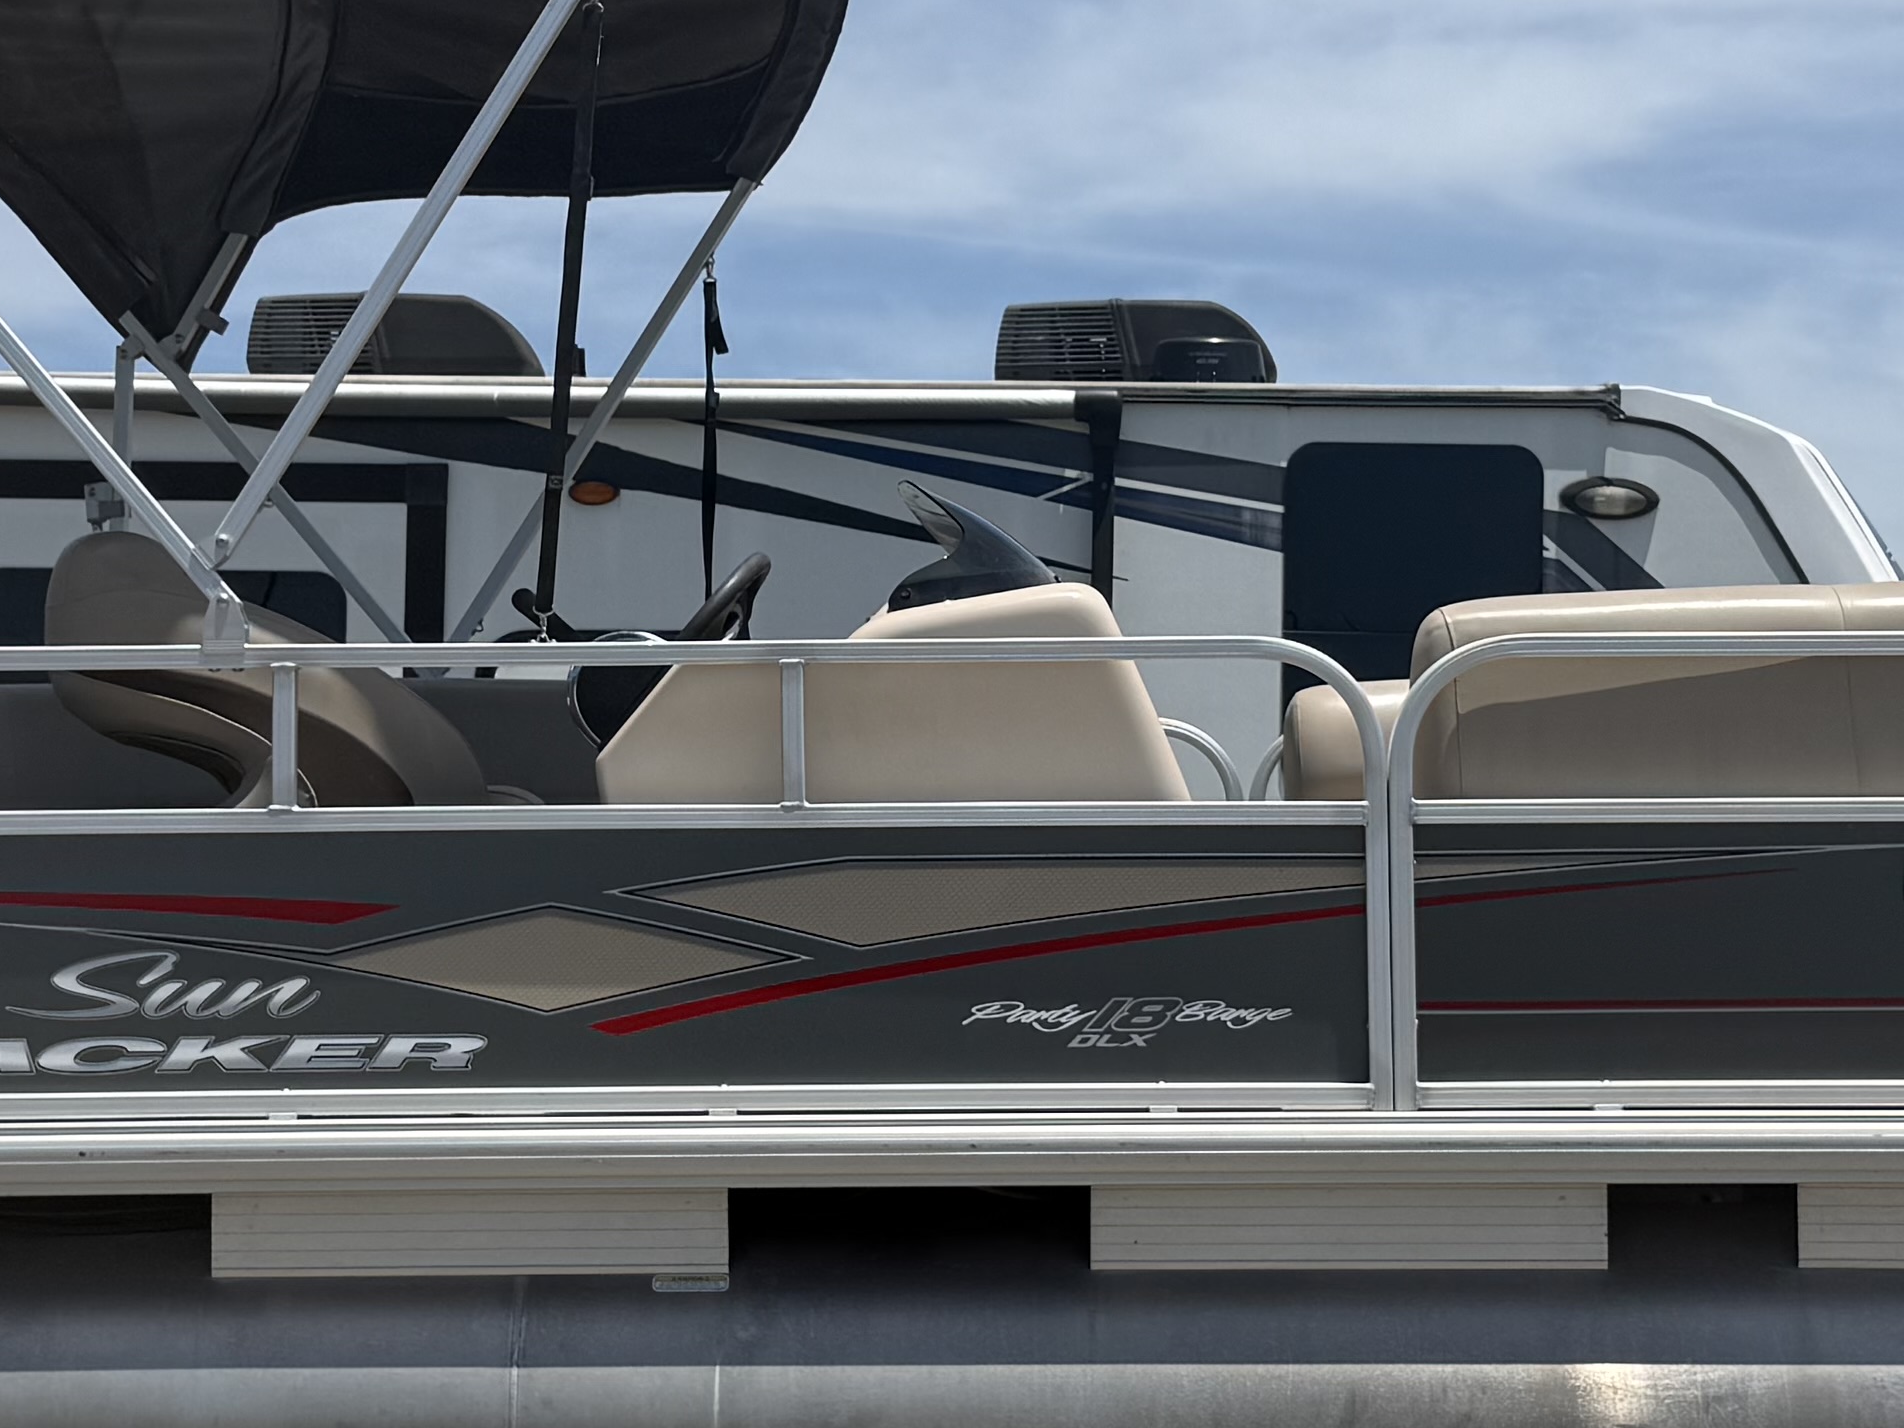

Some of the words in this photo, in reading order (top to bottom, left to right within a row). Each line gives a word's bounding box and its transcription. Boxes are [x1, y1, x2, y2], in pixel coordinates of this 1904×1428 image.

[4, 951, 321, 1019] Sun
[961, 1001, 1097, 1032] Party
[1082, 997, 1184, 1031] 18
[1175, 1000, 1293, 1028] Barge
[1067, 1033, 1157, 1048] DLX
